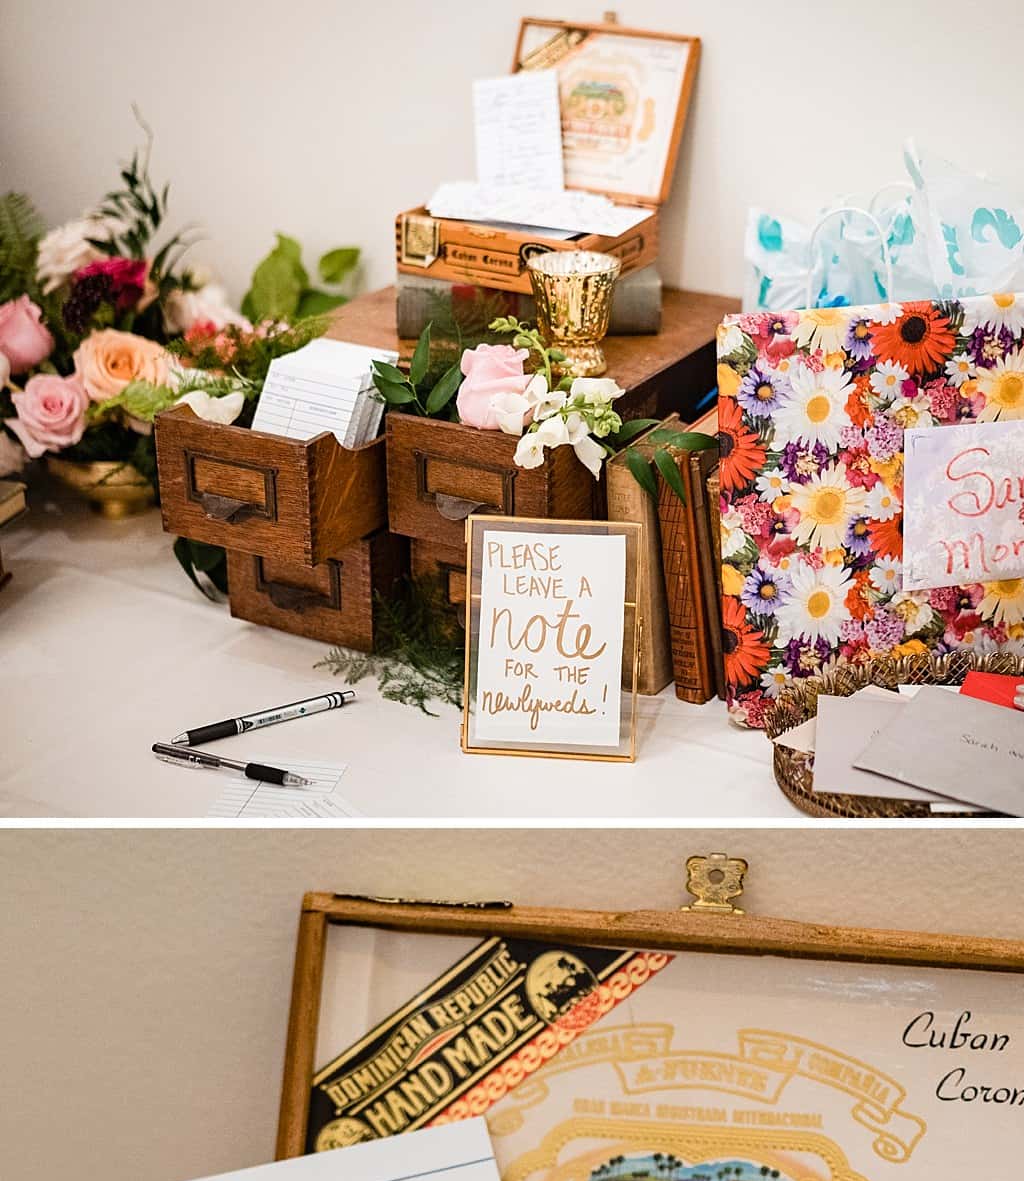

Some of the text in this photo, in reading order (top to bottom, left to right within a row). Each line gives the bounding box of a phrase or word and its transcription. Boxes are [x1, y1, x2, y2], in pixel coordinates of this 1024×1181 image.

[487, 541, 562, 571] PLEASE
[503, 574, 593, 599] LEAVE A
[490, 600, 607, 660] note
[504, 659, 591, 685] FOR THE
[326, 951, 518, 1108] DOMINICAN REPUBLIC
[902, 1010, 1010, 1051] Cuban
[365, 993, 540, 1137] HAND MADE
